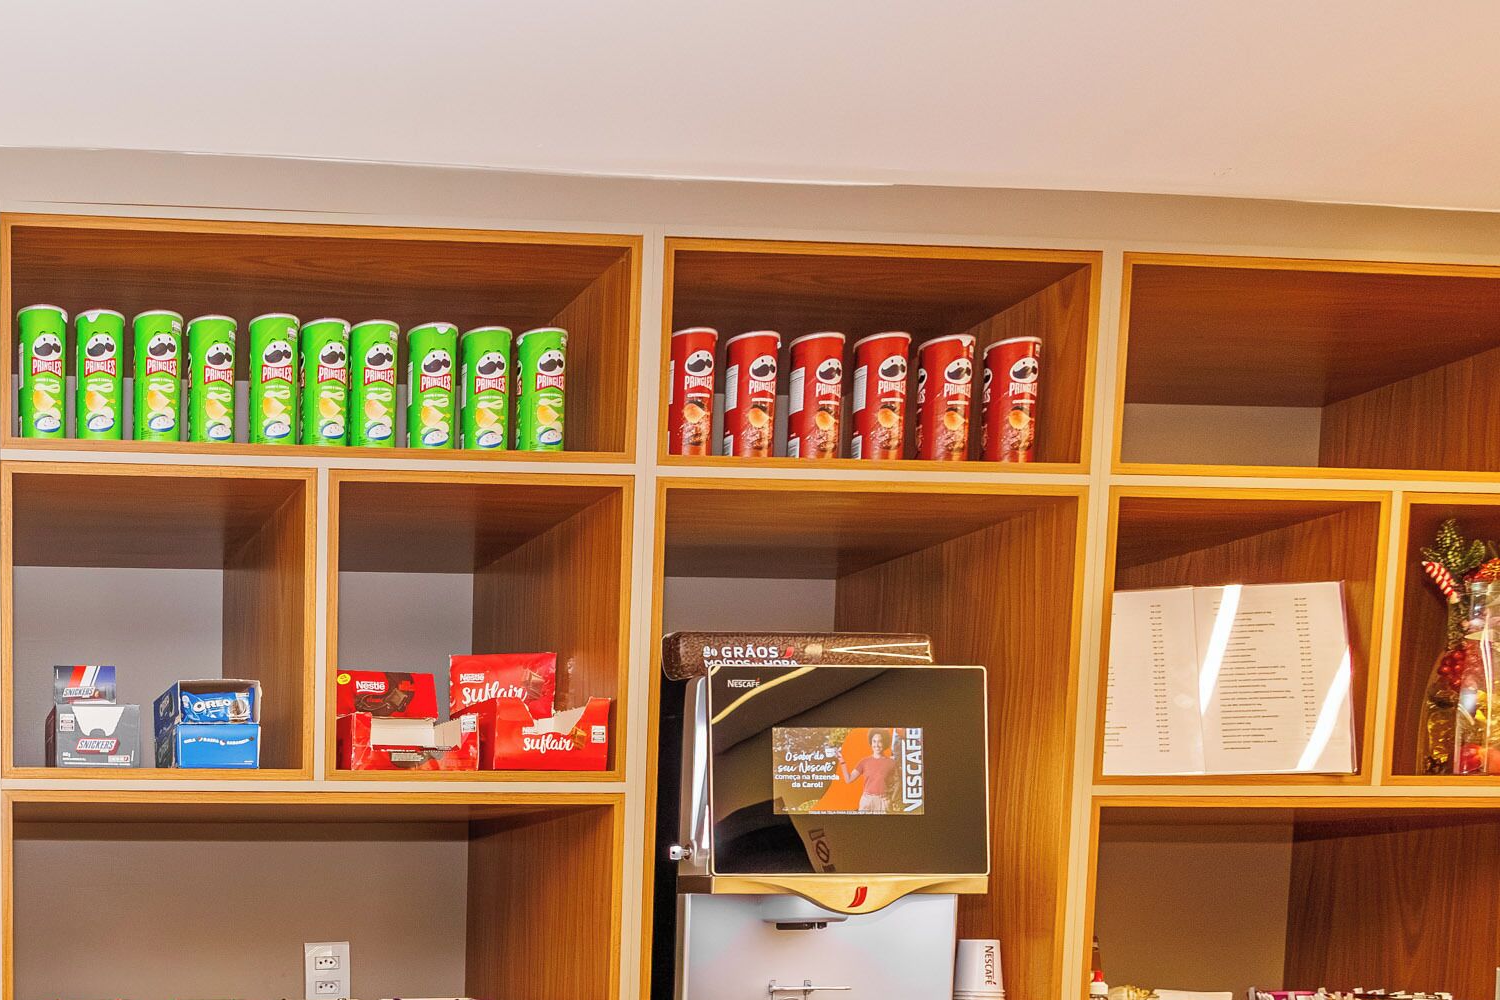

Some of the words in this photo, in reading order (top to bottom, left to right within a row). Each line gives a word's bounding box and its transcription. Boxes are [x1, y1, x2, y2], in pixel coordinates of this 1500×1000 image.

[32, 360, 62, 376] PRINGLES
[85, 360, 116, 376] PRINGLES
[147, 360, 177, 376] PRINGLES
[204, 367, 233, 385] PRINGLES
[262, 366, 292, 383] PRINGLES
[318, 367, 347, 382] PRINGLES
[364, 368, 394, 384] PRINGLES
[421, 375, 451, 391] PRINGLES
[475, 377, 506, 393] PRINGLES
[536, 374, 564, 391] PRINGLES
[721, 644, 779, 658] GRÃOS
[62, 687, 95, 698] SNICKERS
[193, 698, 230, 713] OREO
[78, 739, 116, 751] SNICKERS
[523, 734, 574, 753] suflair
[985, 945, 997, 986] NESCAFÉ
